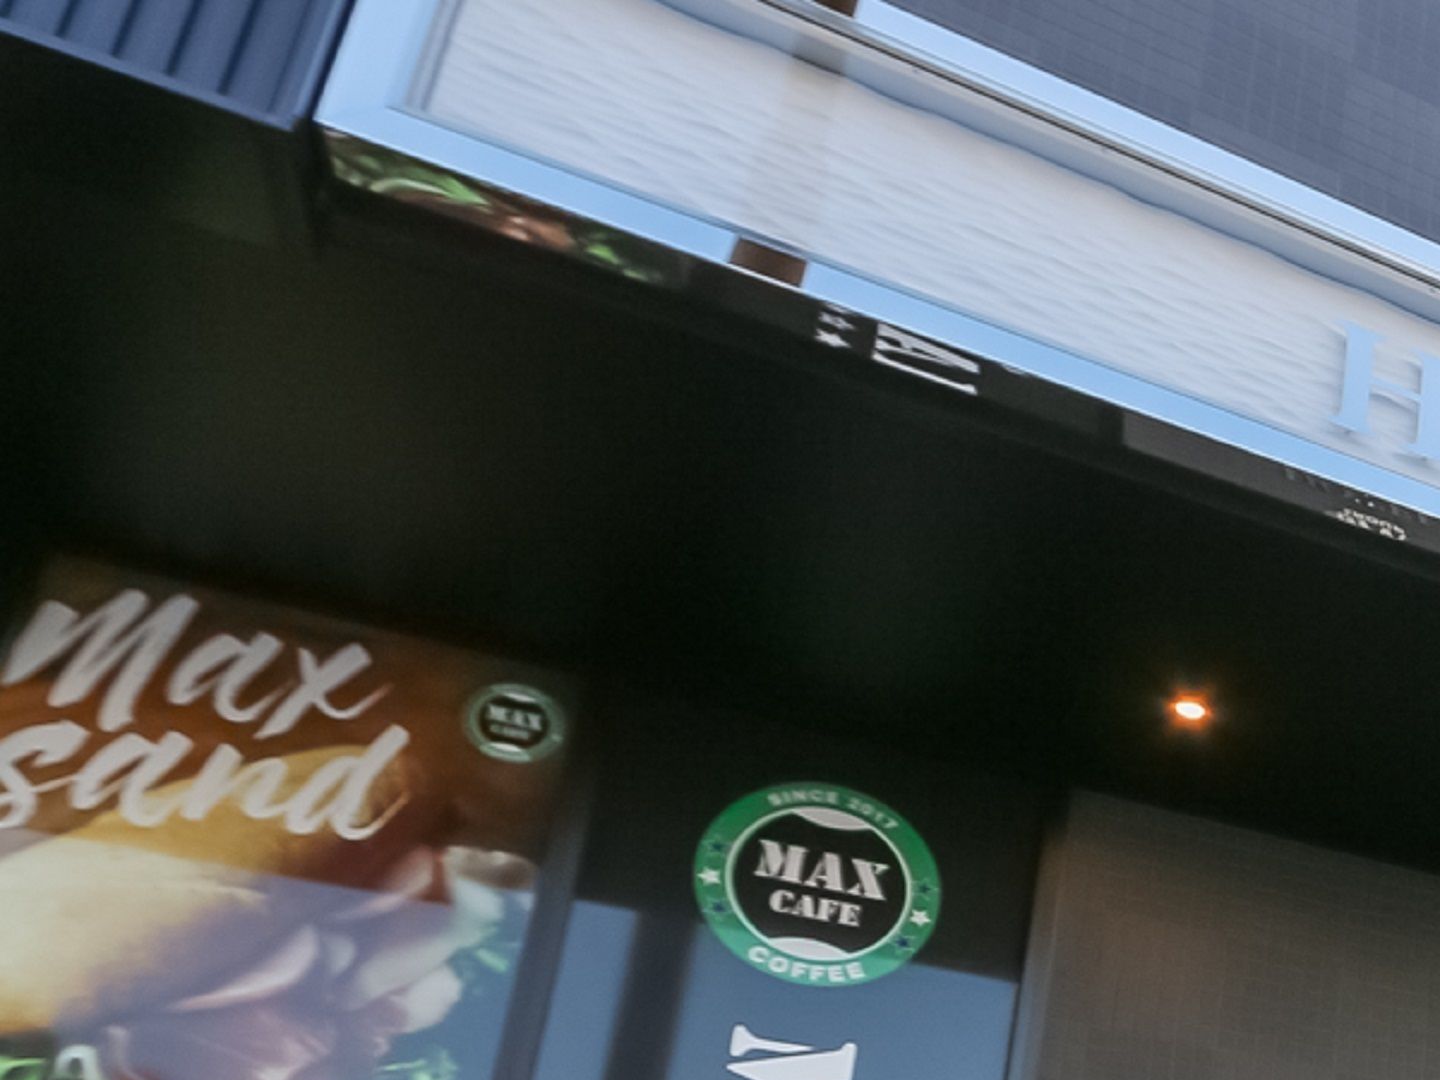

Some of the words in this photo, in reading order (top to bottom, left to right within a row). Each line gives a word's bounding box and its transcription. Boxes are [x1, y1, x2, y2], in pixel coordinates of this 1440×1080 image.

[2, 589, 393, 740] Max
[767, 789, 838, 806] SINCE
[847, 798, 899, 829] 2017
[753, 838, 891, 901] MAX
[768, 889, 863, 927] CAFE
[747, 946, 866, 982] COFFEE
